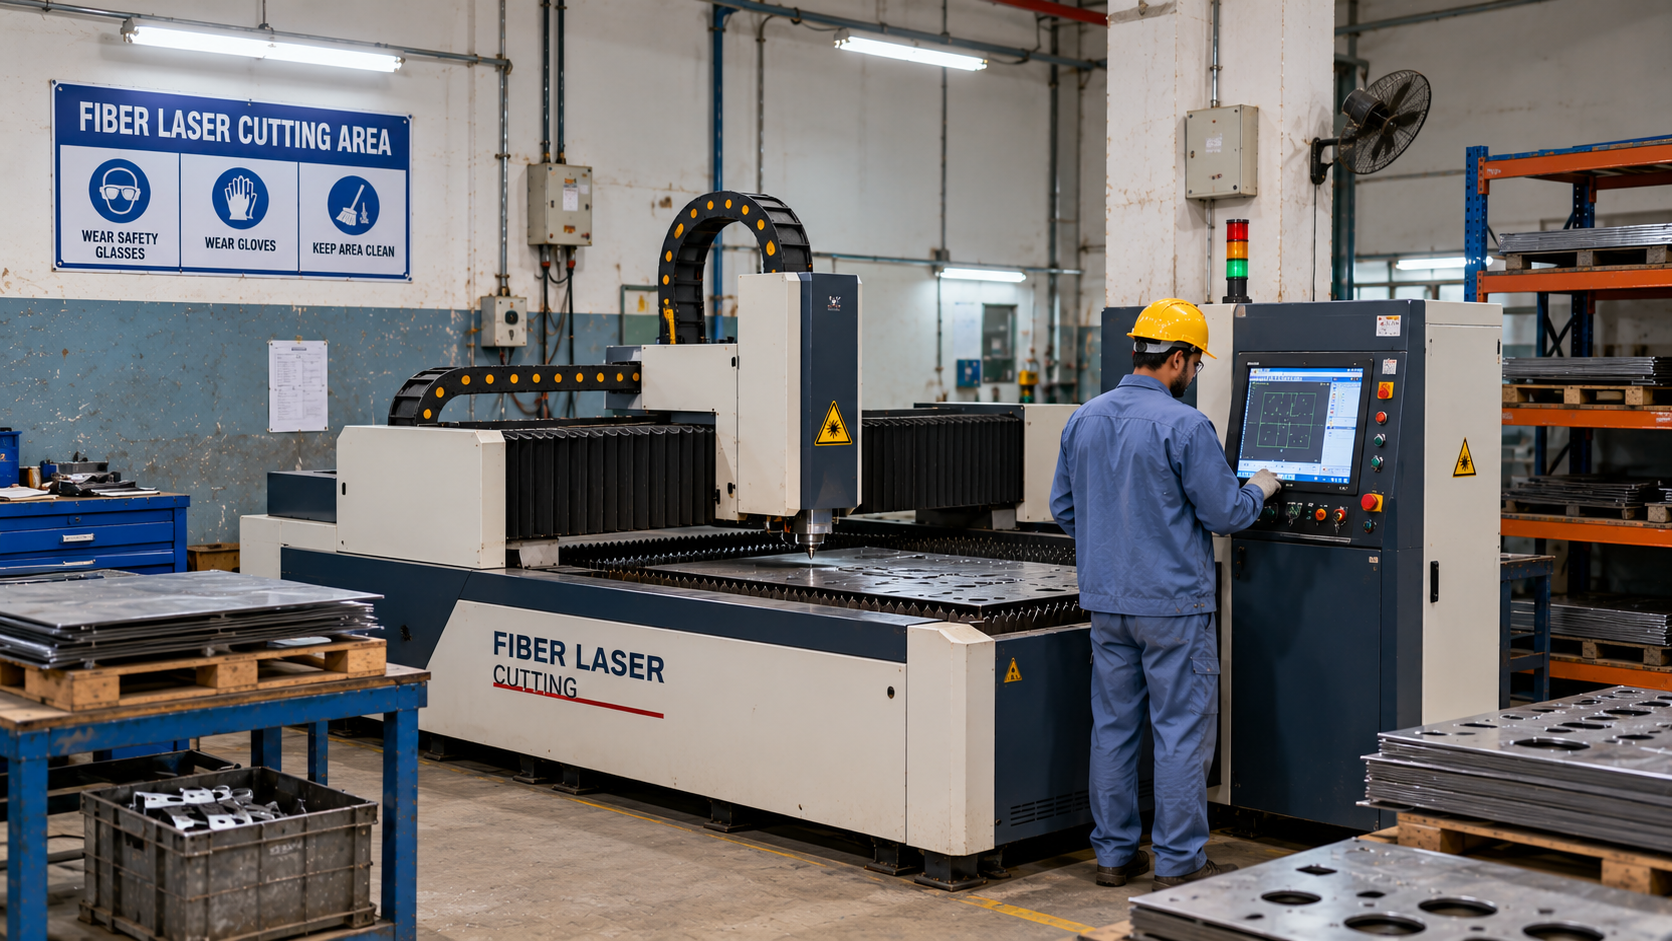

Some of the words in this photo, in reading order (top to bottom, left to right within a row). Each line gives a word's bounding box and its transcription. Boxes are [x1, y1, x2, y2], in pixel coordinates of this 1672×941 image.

[79, 101, 150, 136] FIBER
[158, 108, 231, 143] LASER
[238, 115, 331, 151] CUTTING
[337, 124, 392, 156] AREA
[81, 229, 114, 243] WEAR
[117, 231, 158, 245] SAFETY
[205, 236, 235, 250] WEAR
[238, 238, 276, 251] GLOVES
[95, 245, 145, 260] GLASSES
[313, 242, 337, 255] KEEP
[338, 243, 363, 256] AREA
[365, 244, 395, 257] CLEAN
[493, 630, 566, 667] FIBER
[576, 643, 665, 684] LASER
[493, 664, 577, 698] CUTTING
